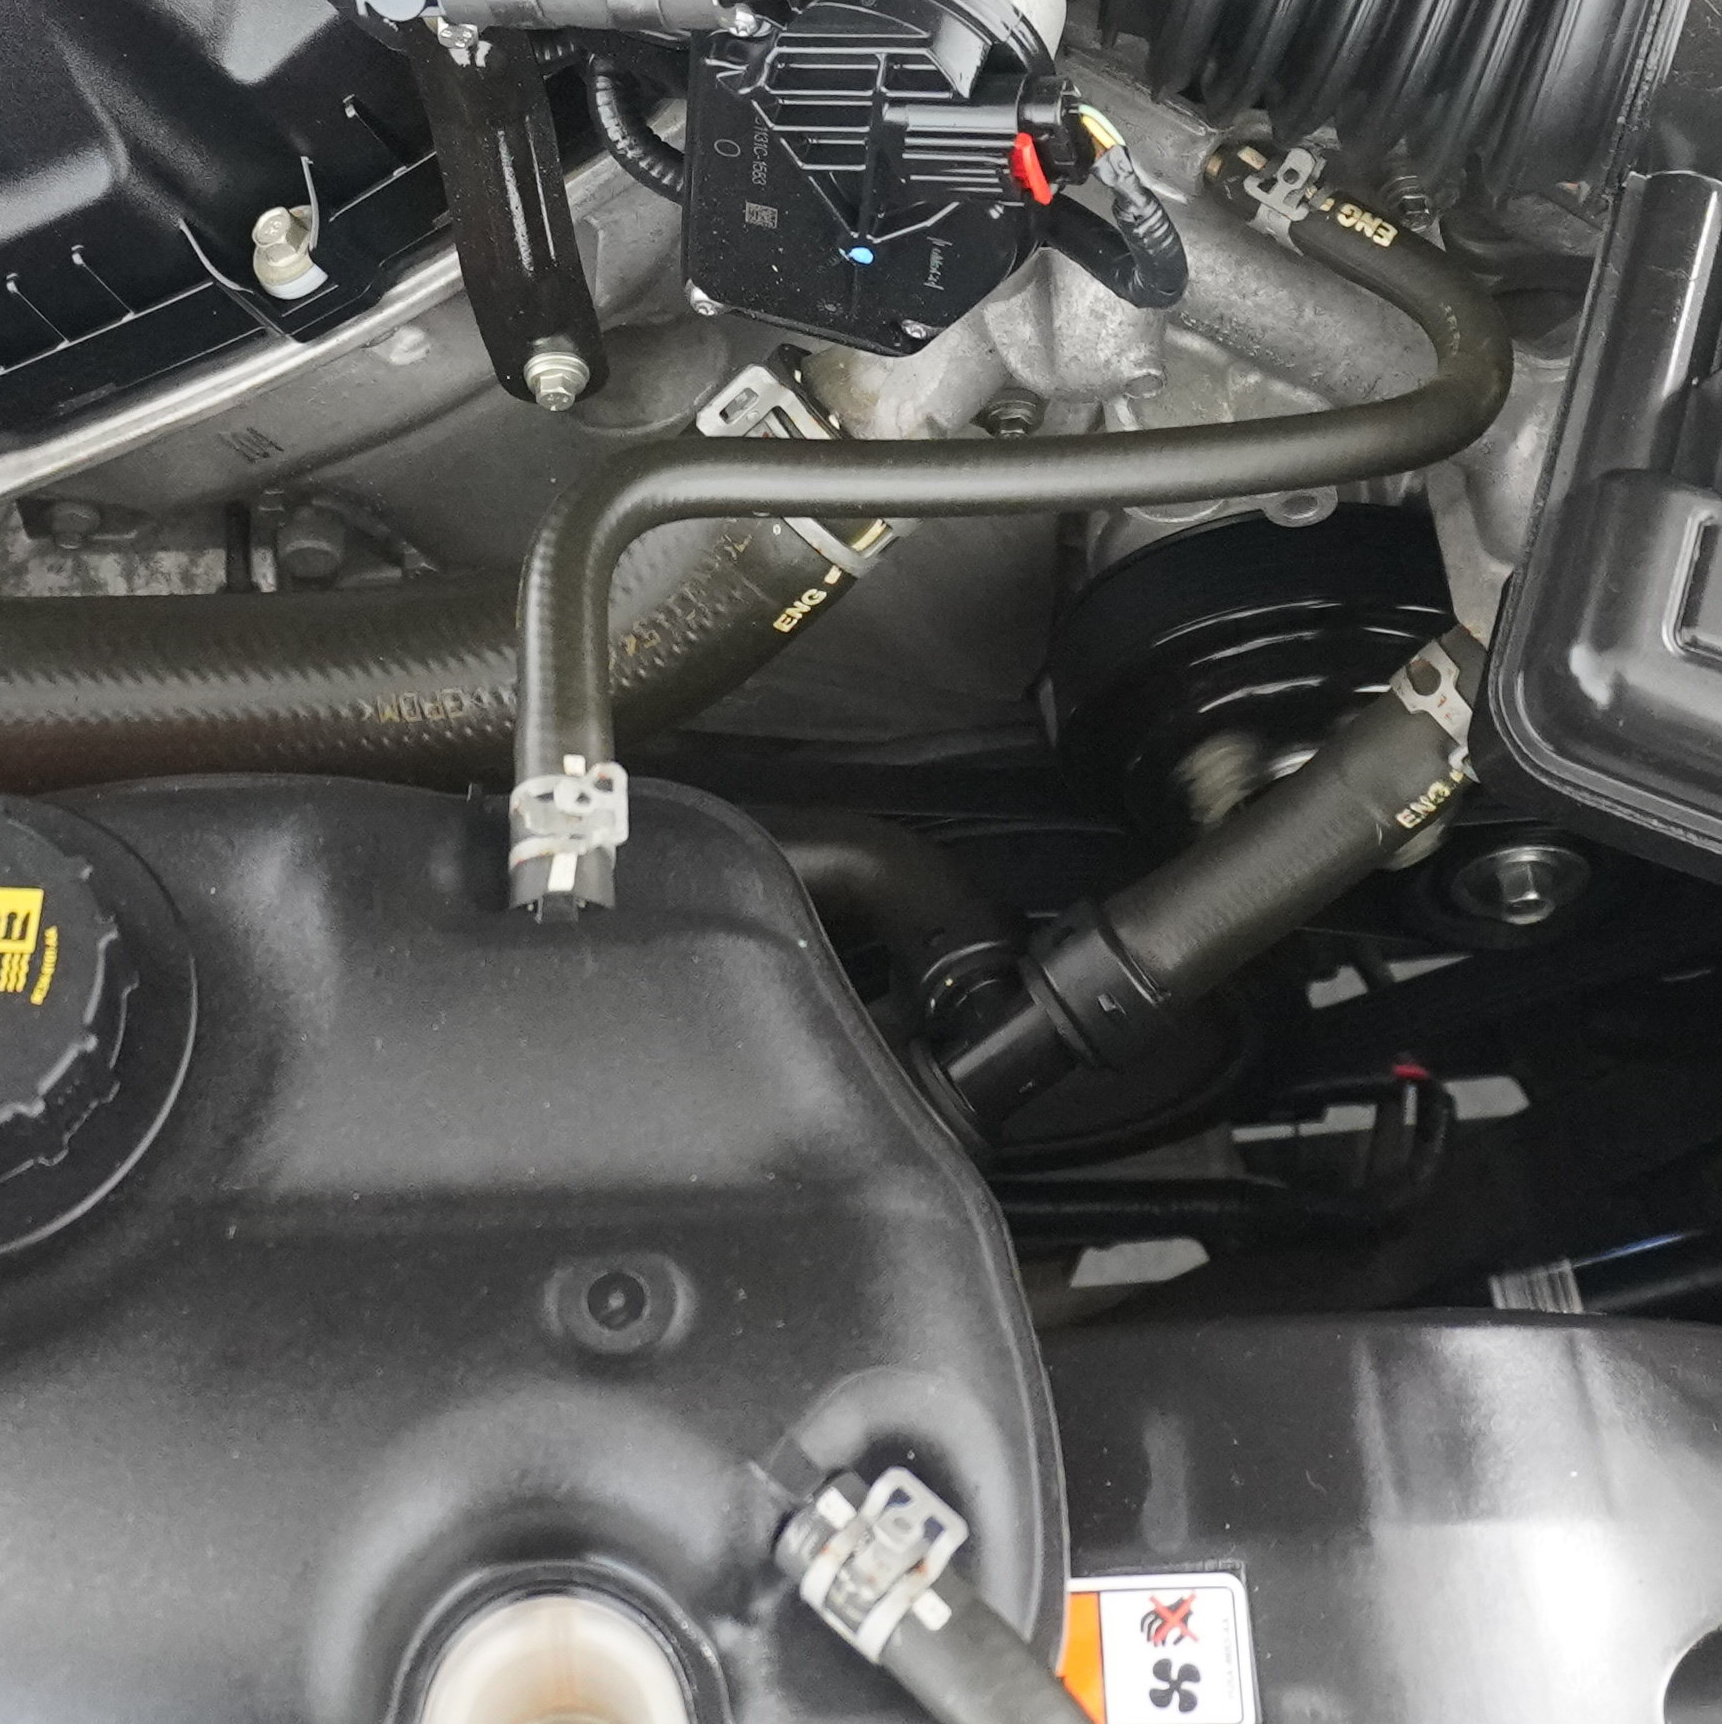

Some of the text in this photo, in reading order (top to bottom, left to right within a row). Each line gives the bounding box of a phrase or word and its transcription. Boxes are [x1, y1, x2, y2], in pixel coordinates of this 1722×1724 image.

[1337, 203, 1398, 247] ENG
[773, 587, 828, 632] ENG
[1396, 781, 1451, 828] ENG
